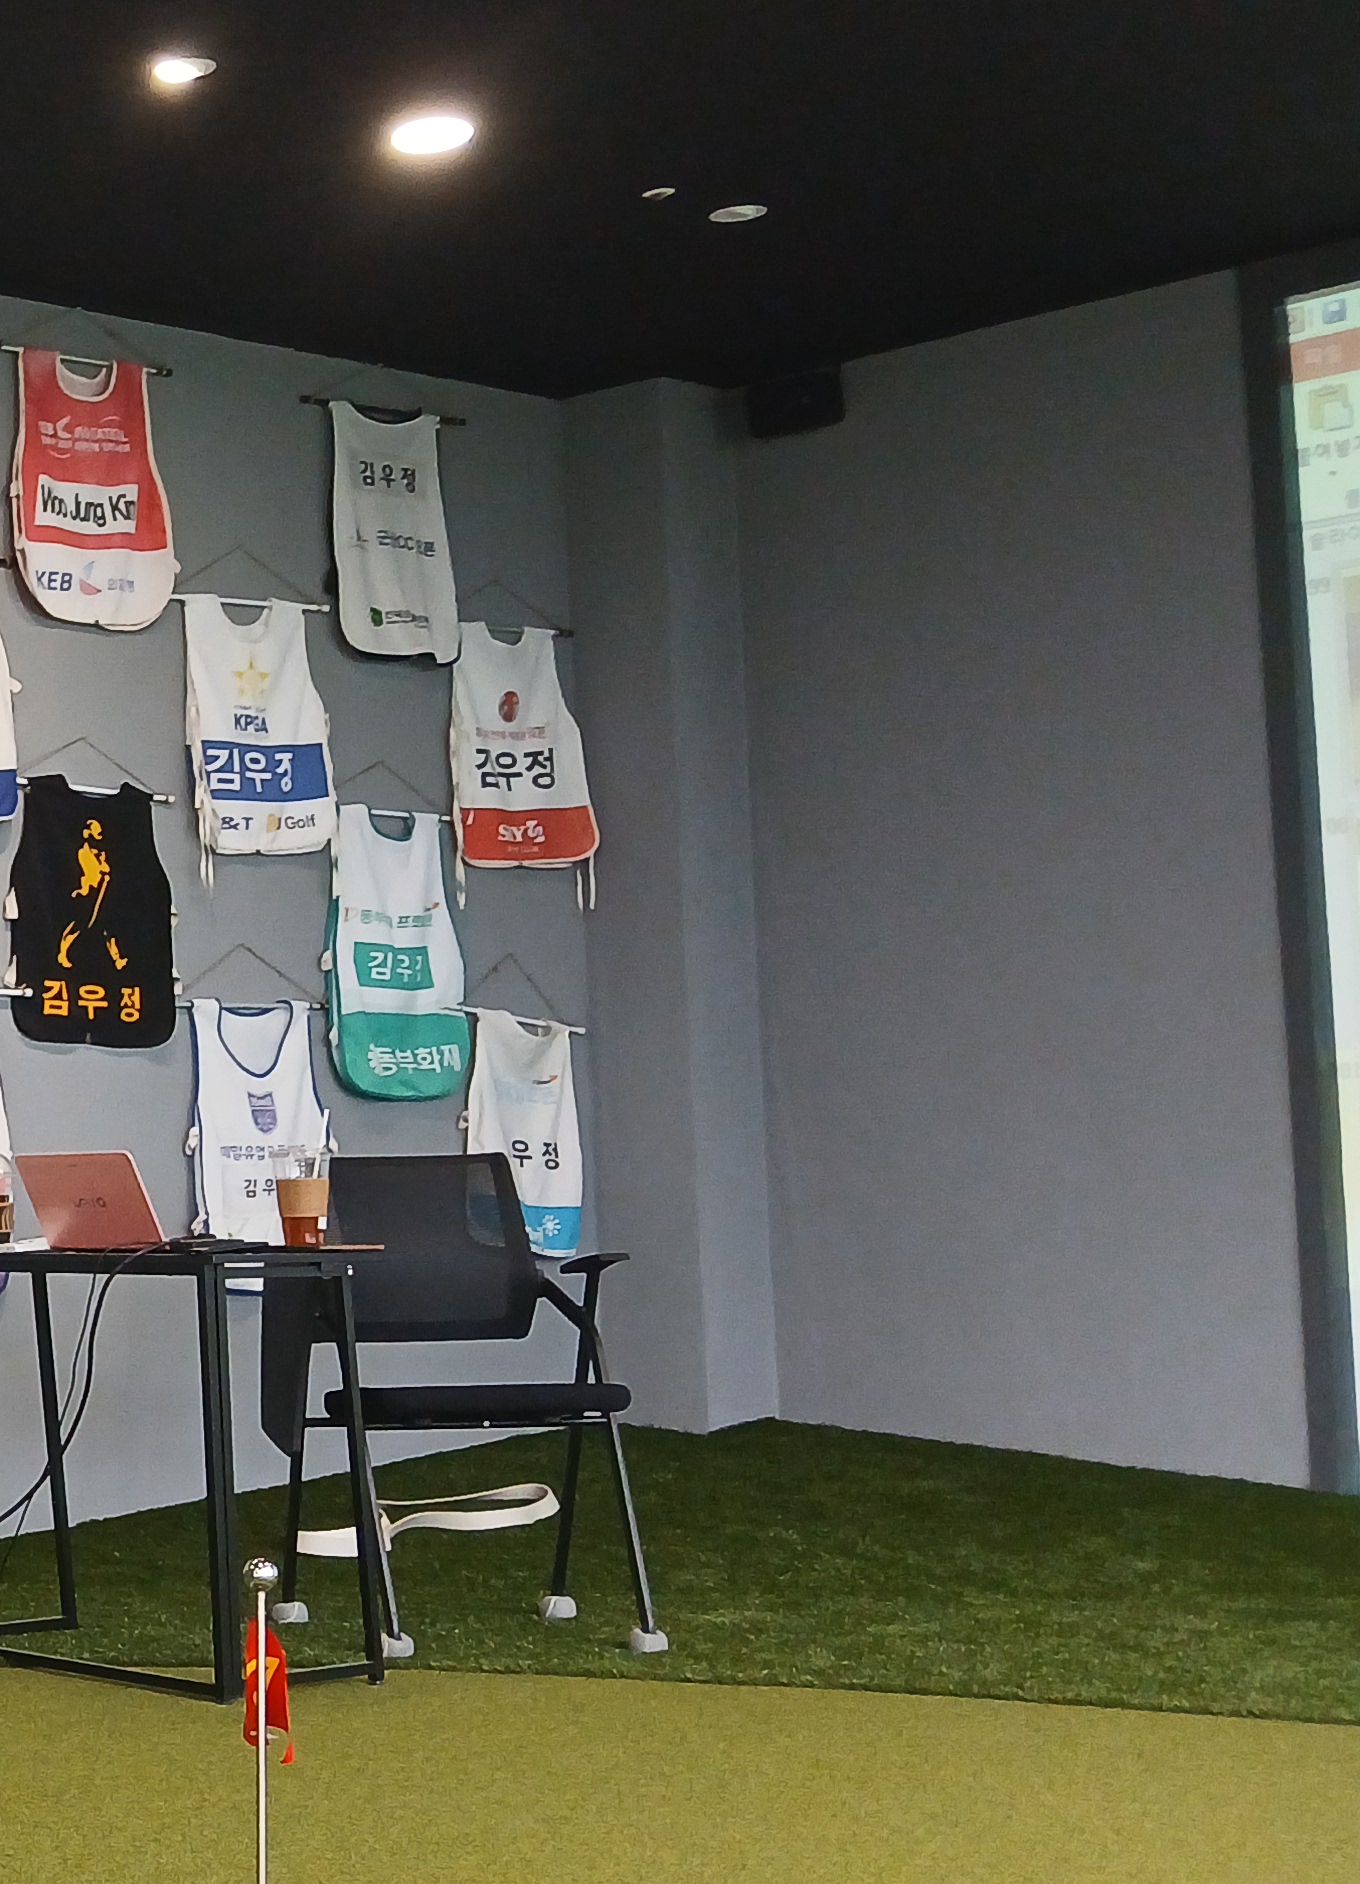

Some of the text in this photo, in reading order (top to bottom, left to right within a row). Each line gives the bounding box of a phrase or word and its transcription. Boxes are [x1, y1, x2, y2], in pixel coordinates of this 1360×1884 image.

[359, 460, 416, 494] 김우정
[35, 569, 73, 592] KEB
[233, 712, 269, 734] KPGA
[204, 748, 294, 794] 김우정
[474, 747, 556, 792] 김우정
[284, 813, 316, 830] Golf
[41, 980, 142, 1023] 김우정
[372, 1043, 462, 1076] 동부화재
